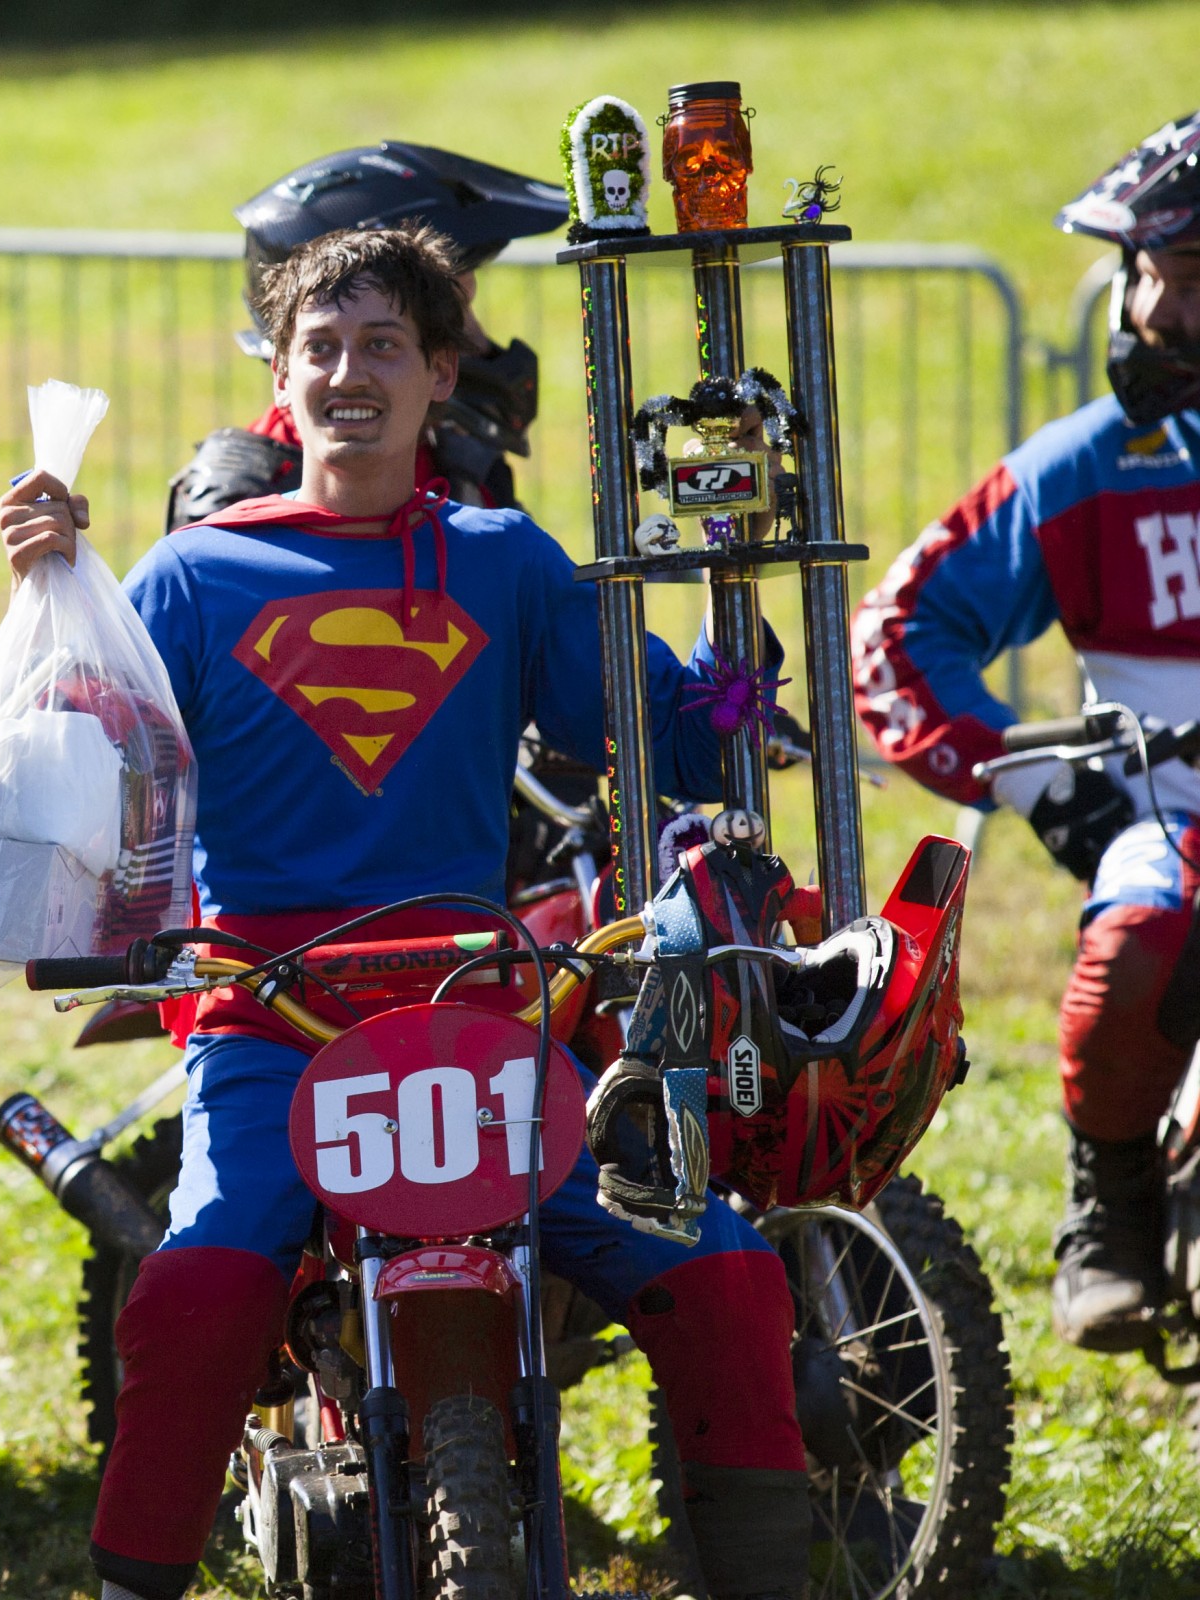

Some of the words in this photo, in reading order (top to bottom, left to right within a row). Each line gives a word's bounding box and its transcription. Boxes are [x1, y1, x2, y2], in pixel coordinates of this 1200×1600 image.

[590, 133, 641, 161] RIP
[695, 469, 732, 491] TJ
[1134, 511, 1200, 630] H
[358, 947, 476, 974] HONDA
[734, 1048, 756, 1107] SHOEI
[313, 1056, 544, 1194] 501
